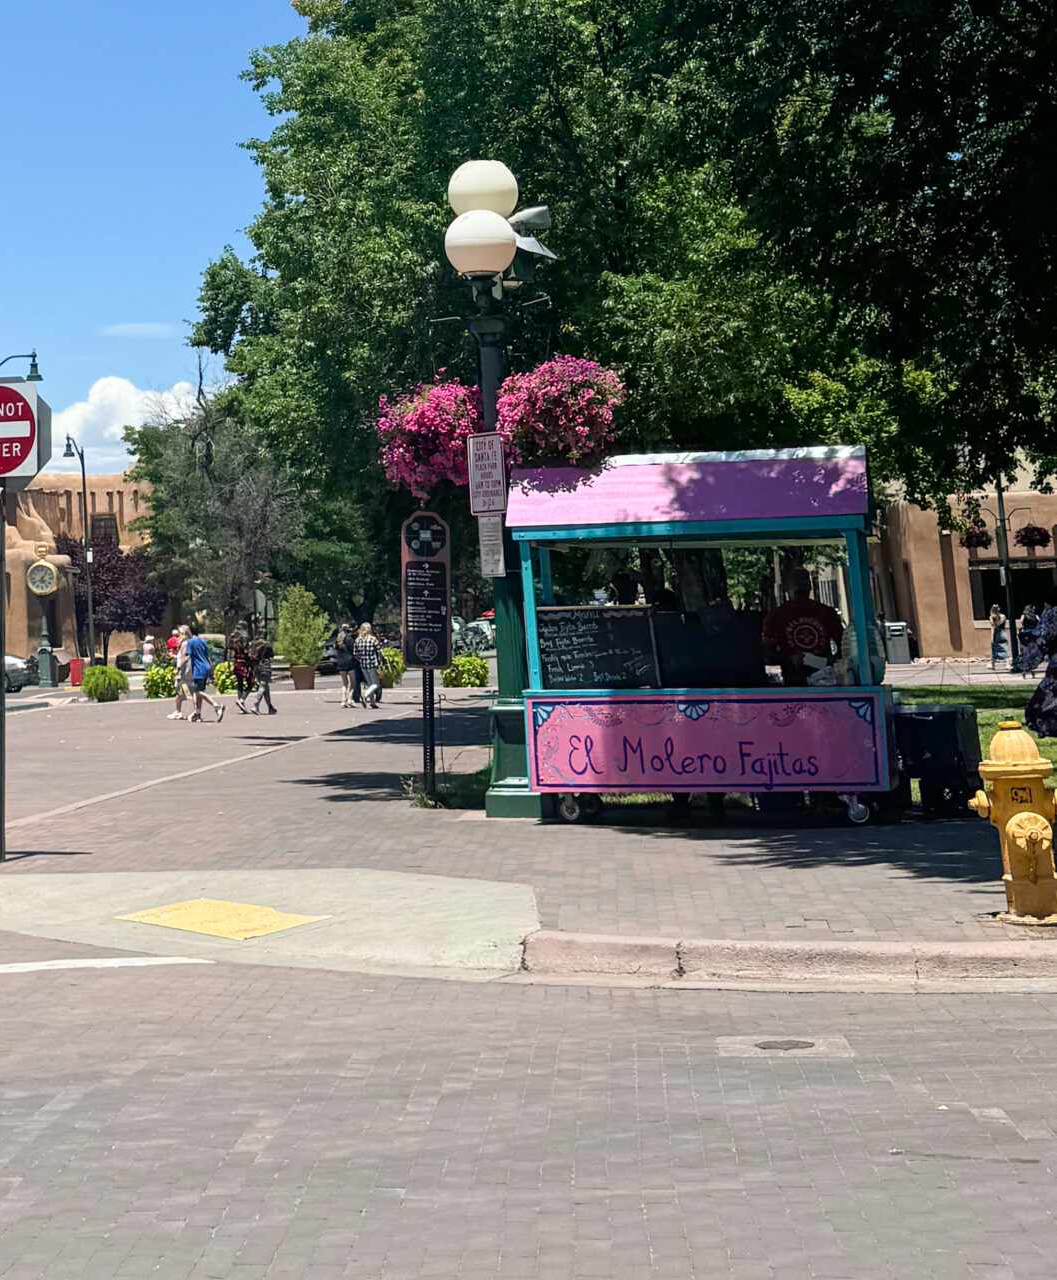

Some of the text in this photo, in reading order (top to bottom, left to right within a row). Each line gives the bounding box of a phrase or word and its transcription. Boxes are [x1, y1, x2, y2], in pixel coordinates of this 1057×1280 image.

[476, 440, 494, 451] CITY OF
[475, 451, 497, 462] SANTA FE
[568, 735, 820, 790] El Molero Fajitas
